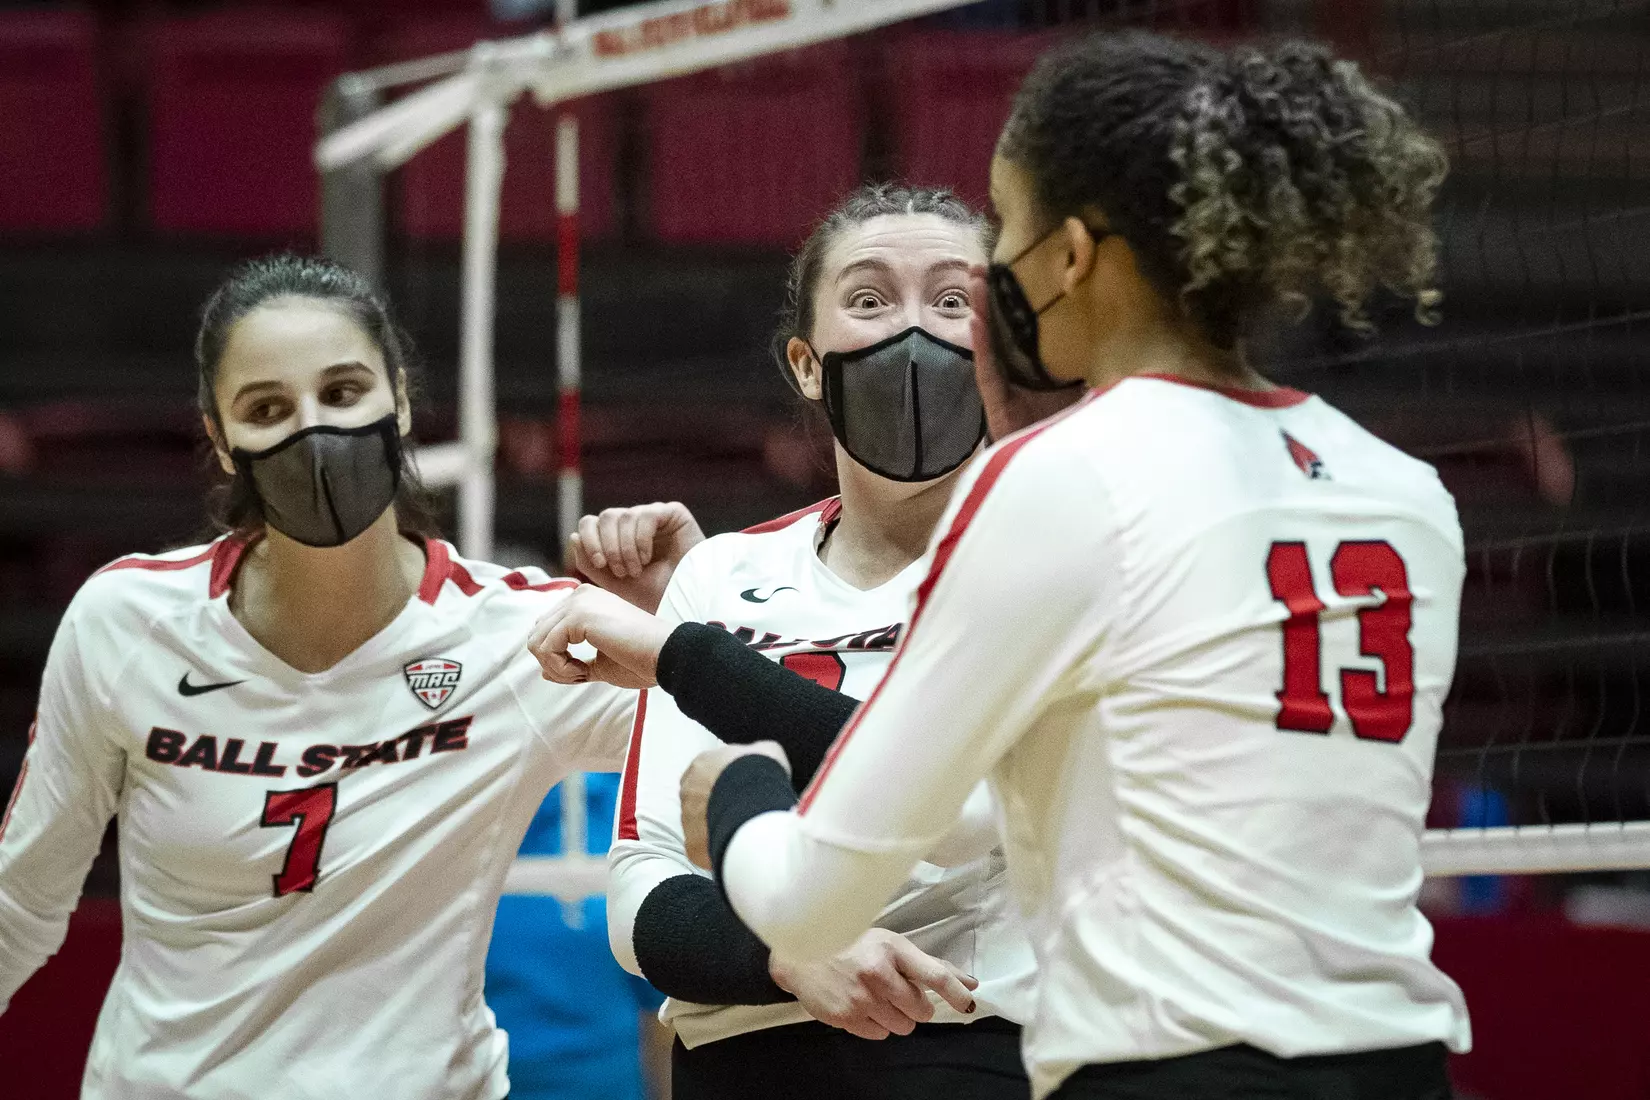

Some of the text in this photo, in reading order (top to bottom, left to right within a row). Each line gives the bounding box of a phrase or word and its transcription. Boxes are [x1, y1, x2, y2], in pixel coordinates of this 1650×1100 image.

[408, 672, 460, 689] MAC
[1266, 540, 1414, 744] 13
[146, 714, 474, 778] BALL STATE
[259, 782, 338, 898] 7
